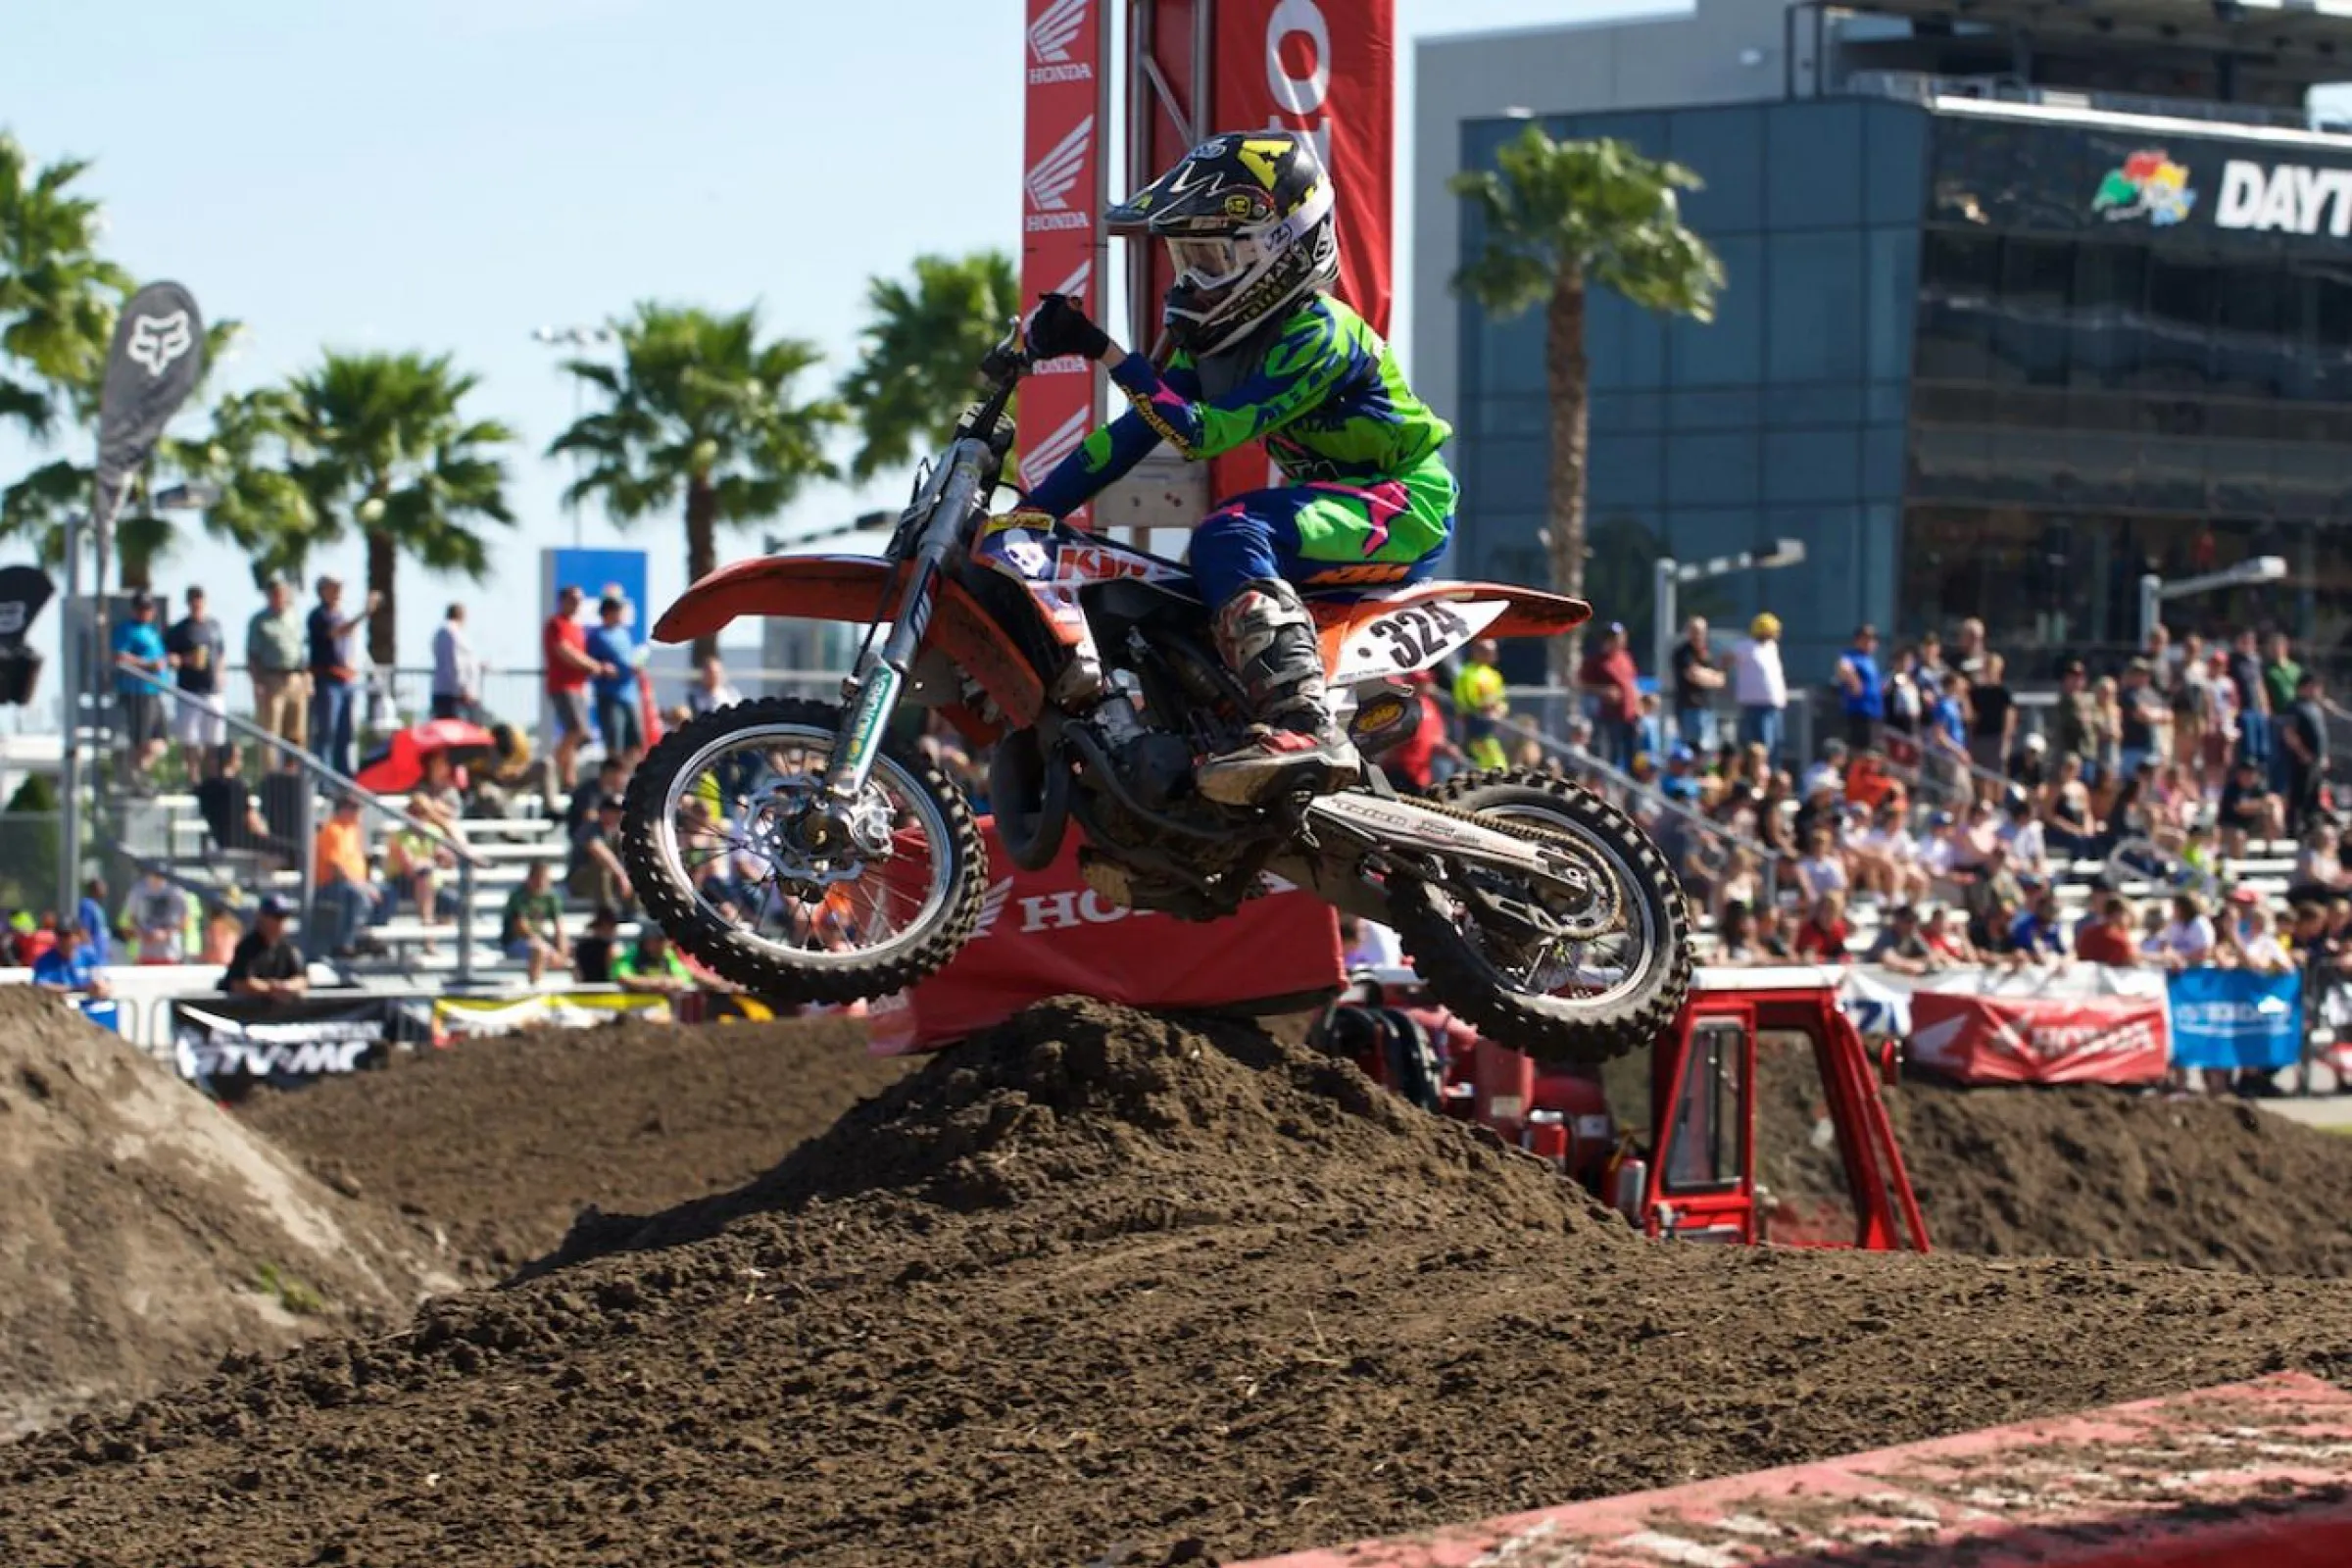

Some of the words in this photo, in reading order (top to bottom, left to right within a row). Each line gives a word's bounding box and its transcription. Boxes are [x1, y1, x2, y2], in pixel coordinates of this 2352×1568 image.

[1028, 63, 1093, 84] HONDA
[2215, 160, 2352, 238] DAYT
[1025, 211, 1091, 232] HONDA
[1369, 600, 1471, 668] 324
